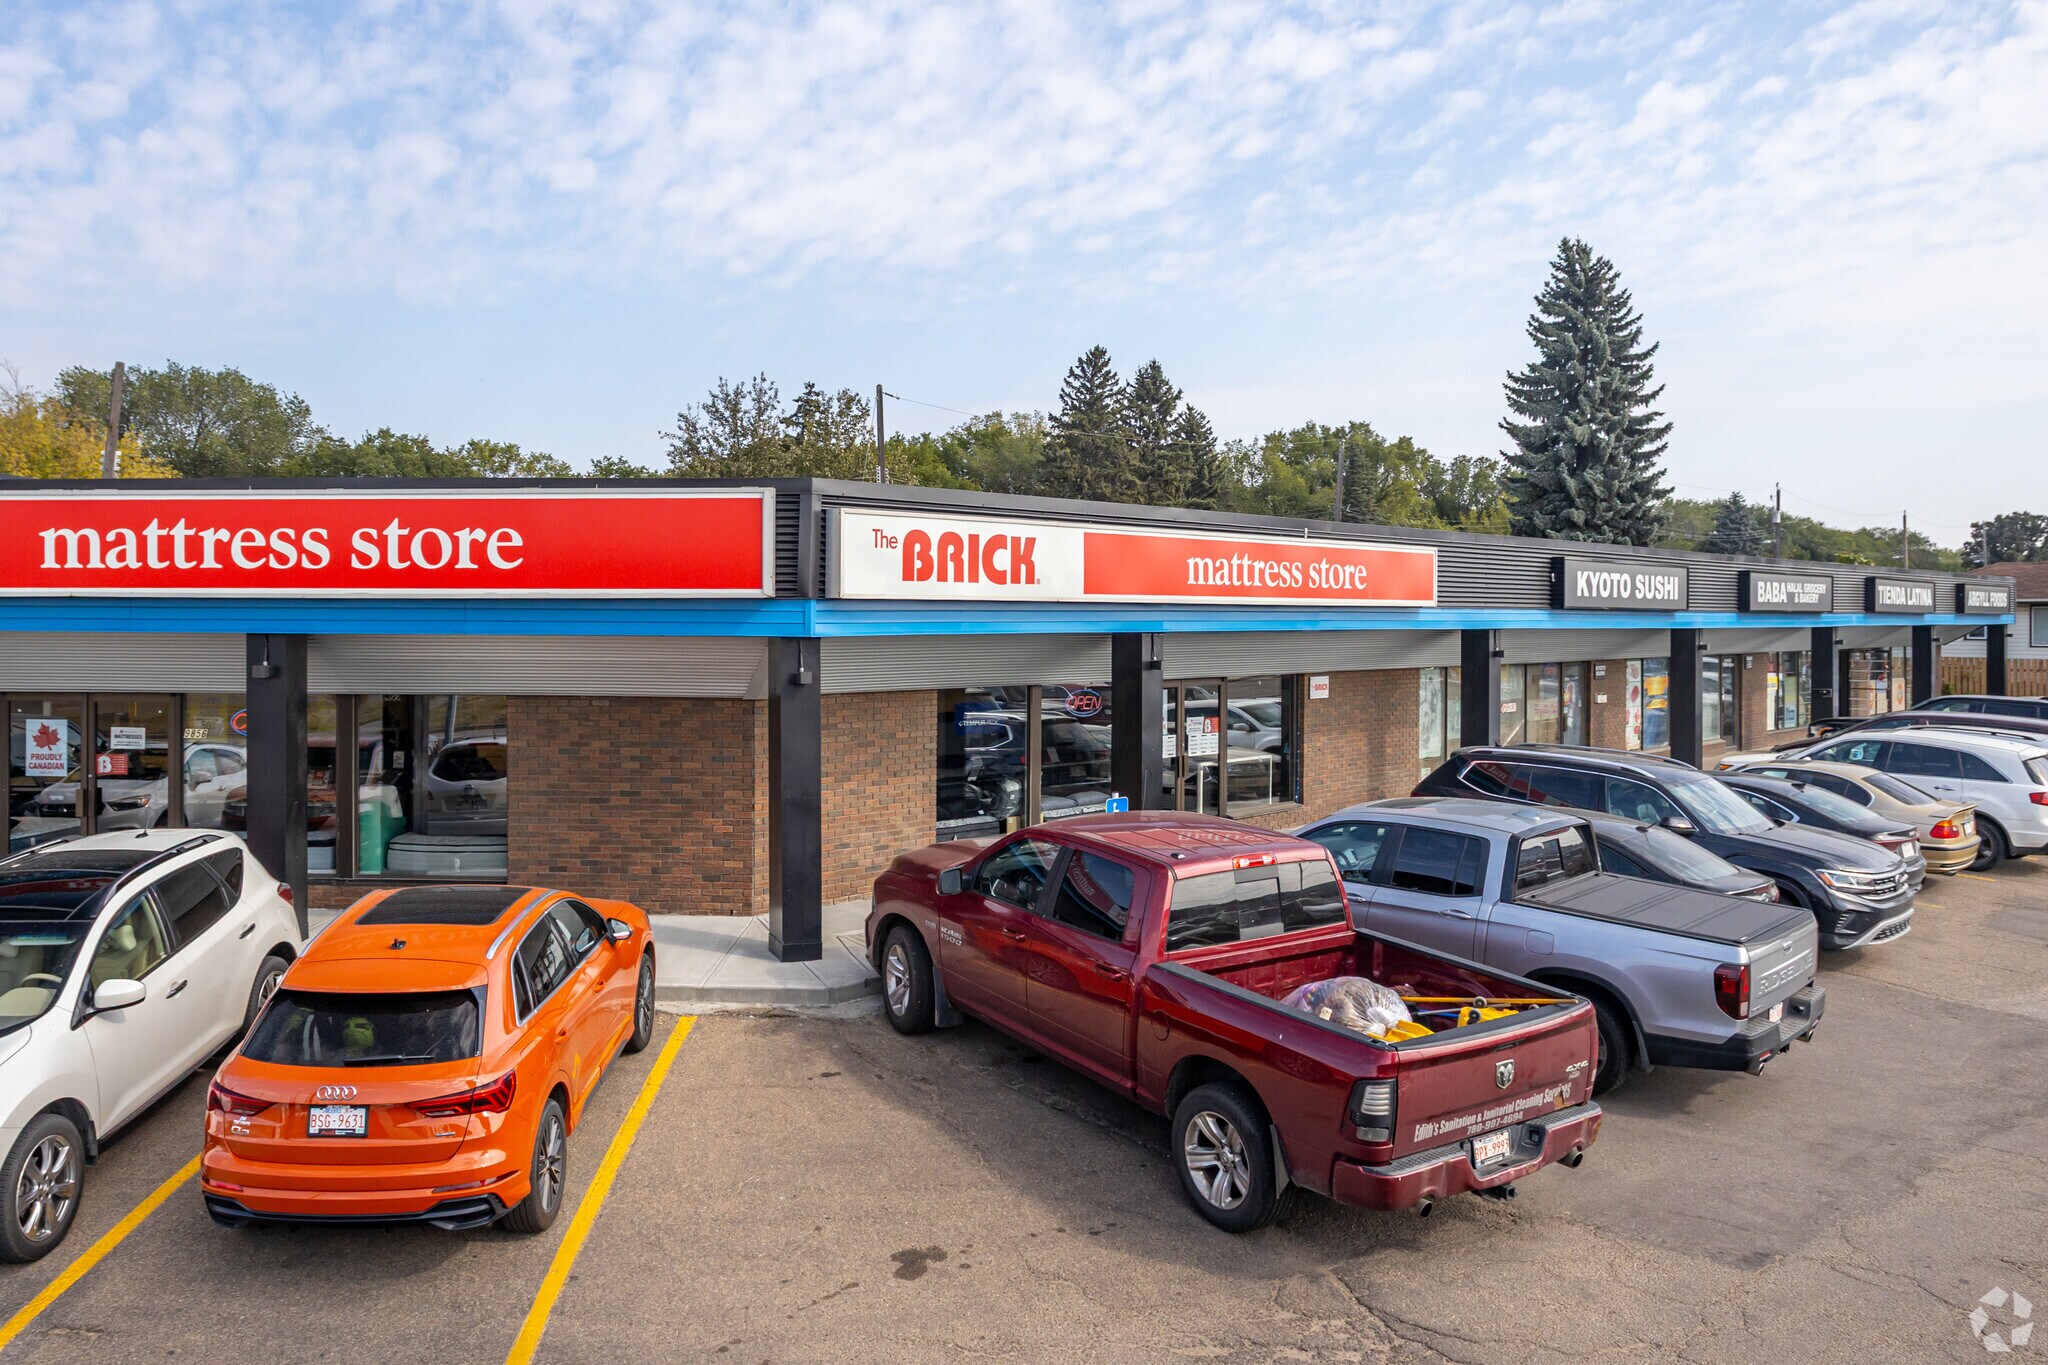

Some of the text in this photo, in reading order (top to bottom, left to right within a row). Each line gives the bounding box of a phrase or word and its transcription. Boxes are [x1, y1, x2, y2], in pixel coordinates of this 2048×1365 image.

[38, 517, 524, 570] mattress store
[872, 528, 1037, 585] The BRICK
[1186, 552, 1368, 590] mattress store
[1576, 570, 1679, 600] KYOTO SUSHI
[1757, 581, 1788, 603] BABA
[1786, 582, 1827, 594] HALAL GROCERY
[1794, 592, 1819, 604] & BAKERY
[1877, 585, 1933, 606] TIENDA LATINA
[1967, 590, 2008, 608] ARGYLL FOODS
[1068, 695, 1102, 711] OPEN
[184, 729, 208, 738] 9856
[28, 762, 65, 770] CANADIAN
[30, 752, 63, 761] PROUDLY
[941, 933, 962, 947] 1500
[311, 1114, 364, 1128] BSG-9631
[1413, 1122, 1439, 1143] Edith's
[1439, 1114, 1477, 1135] Sanitation
[1477, 1111, 1482, 1121] &
[1482, 1101, 1515, 1121] Janitorial
[1515, 1093, 1544, 1112] Cleaning
[1466, 1110, 1524, 1135] 780-907-4694
[1474, 1138, 1510, 1161] BPX-9993
